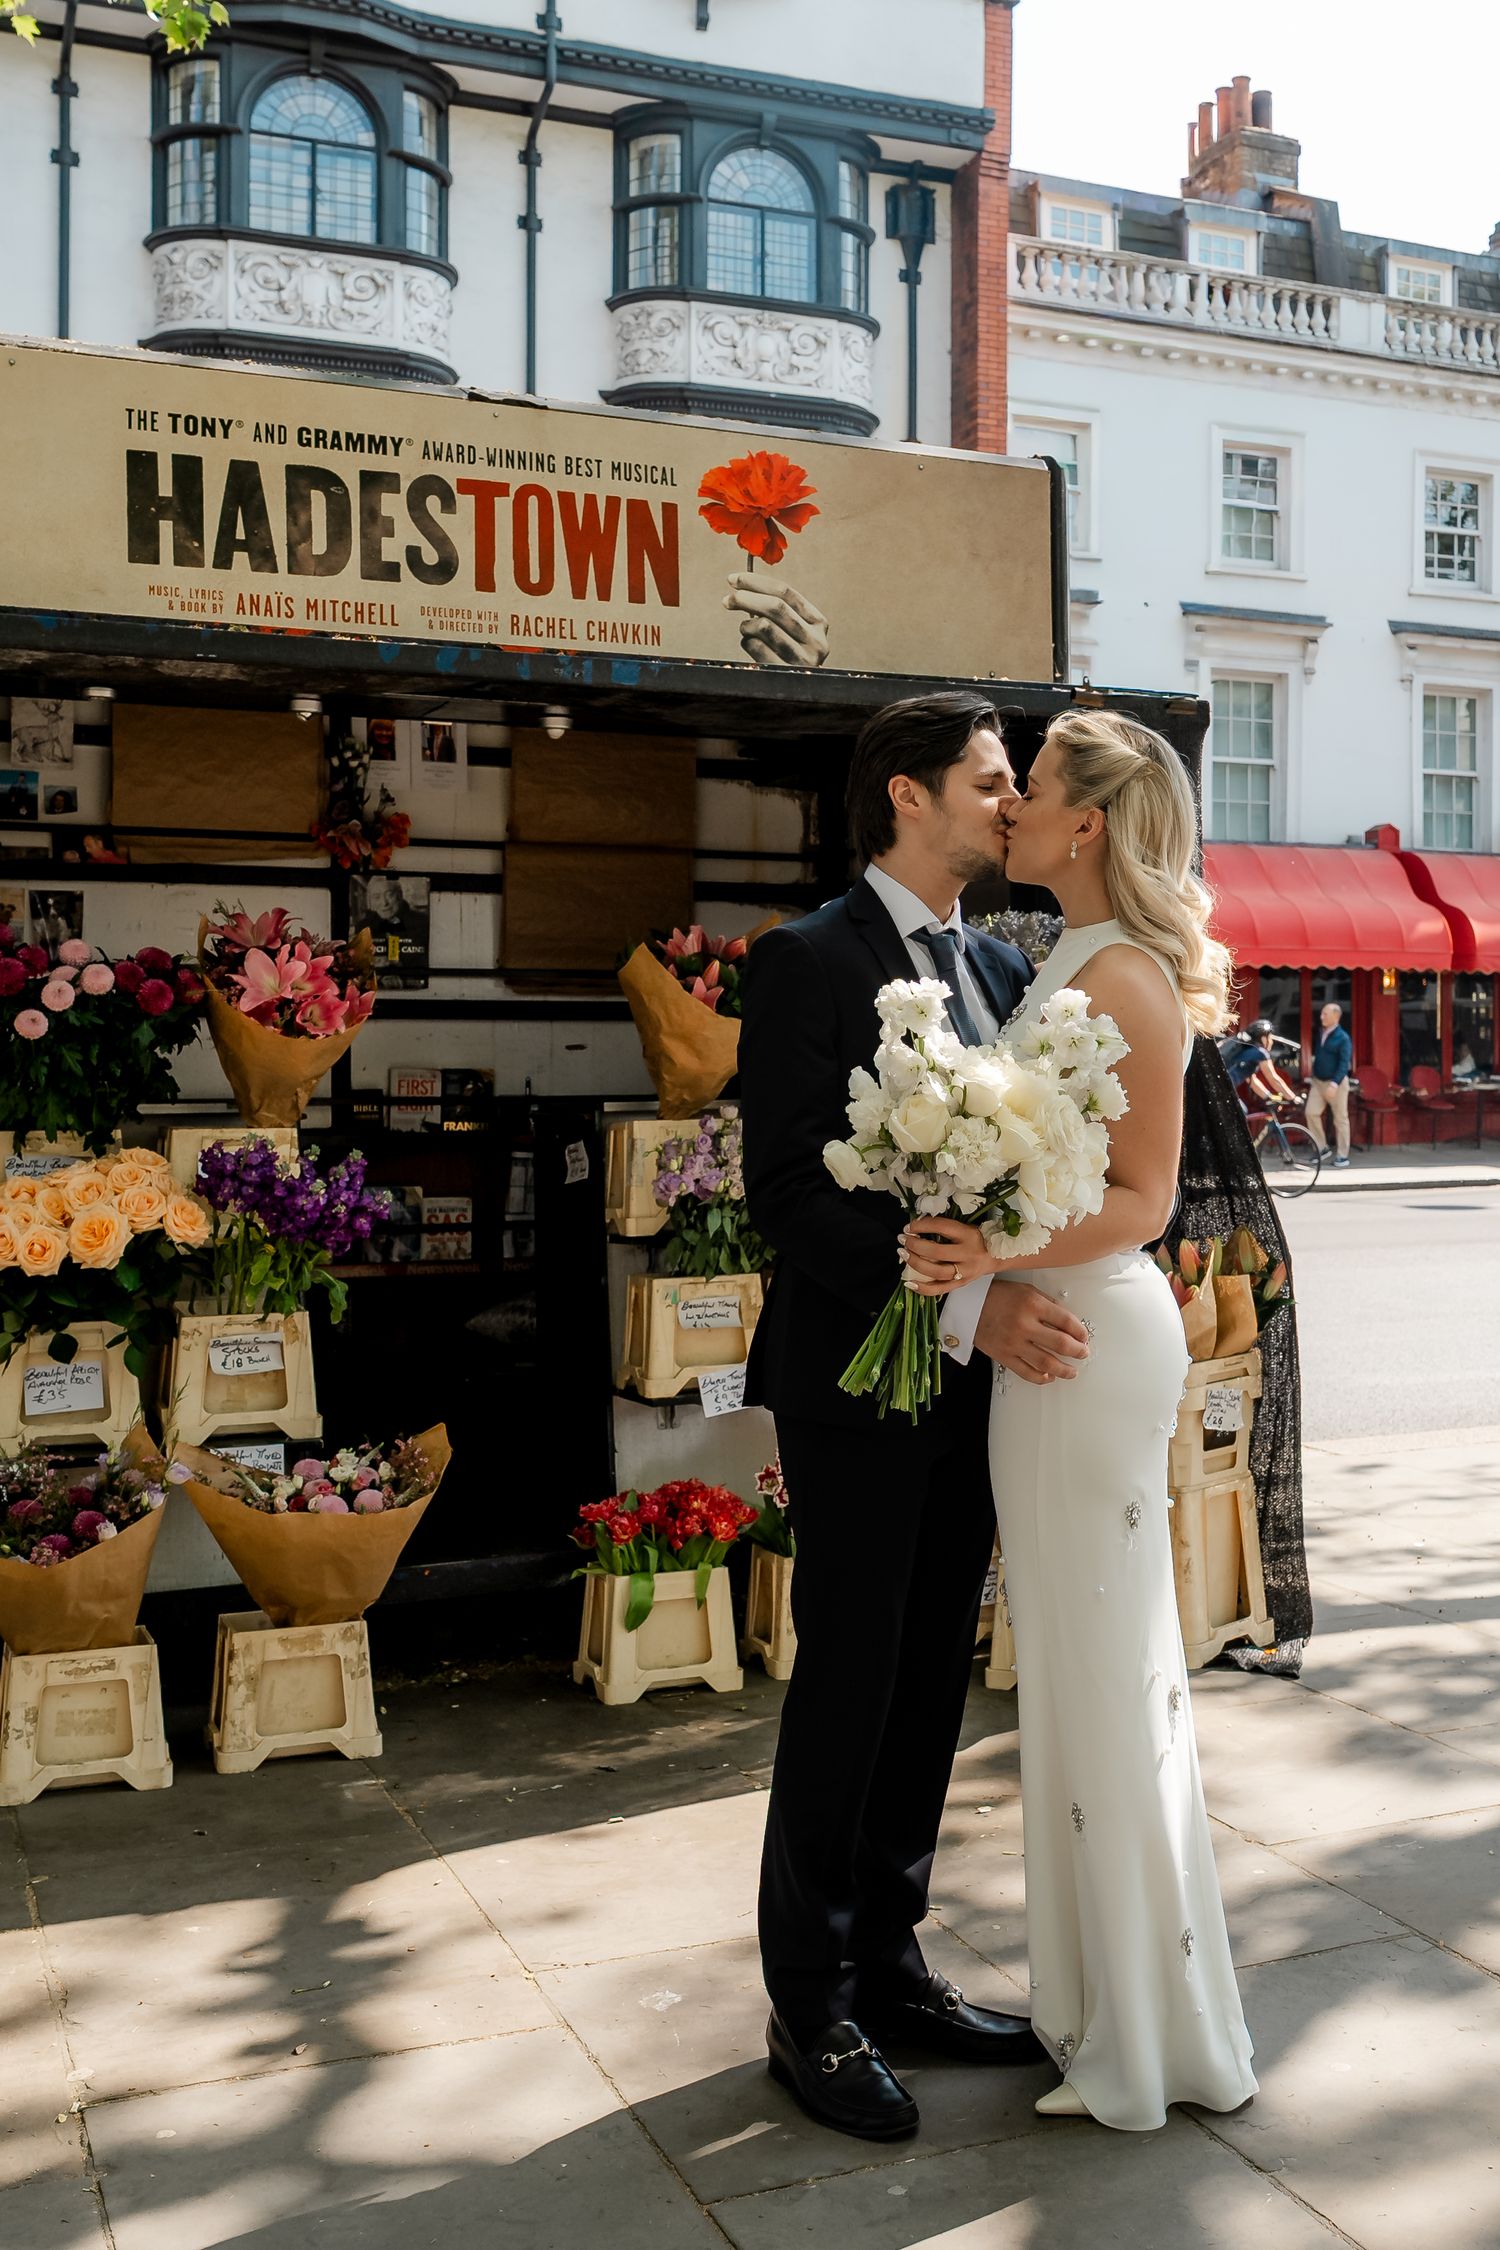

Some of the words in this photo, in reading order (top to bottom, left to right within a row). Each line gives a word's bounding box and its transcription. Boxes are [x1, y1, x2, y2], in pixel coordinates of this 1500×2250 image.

[125, 408, 159, 432] THE
[253, 422, 287, 445] AND
[422, 440, 556, 473] AWARD-WINNING
[565, 455, 602, 479] BEST
[611, 461, 678, 487] MUSICAL
[126, 449, 681, 607] HADESTOWN
[148, 585, 183, 599] MUSIC,
[189, 587, 224, 601] LYRICS
[168, 600, 174, 611] &
[180, 600, 207, 613] BOOK
[212, 603, 224, 614] BY
[236, 591, 295, 619] ANAÏS
[306, 598, 400, 627] MITCHELL
[420, 605, 472, 620] DEVELOPED
[477, 610, 499, 622] WITH
[428, 619, 434, 630] &
[439, 619, 483, 634] DIRECTED
[488, 623, 499, 635] BY
[510, 613, 577, 640] RACHEL
[586, 620, 661, 647] CHAVKIN
[397, 1079, 436, 1096] FIRST
[32, 1389, 67, 1405] £35
